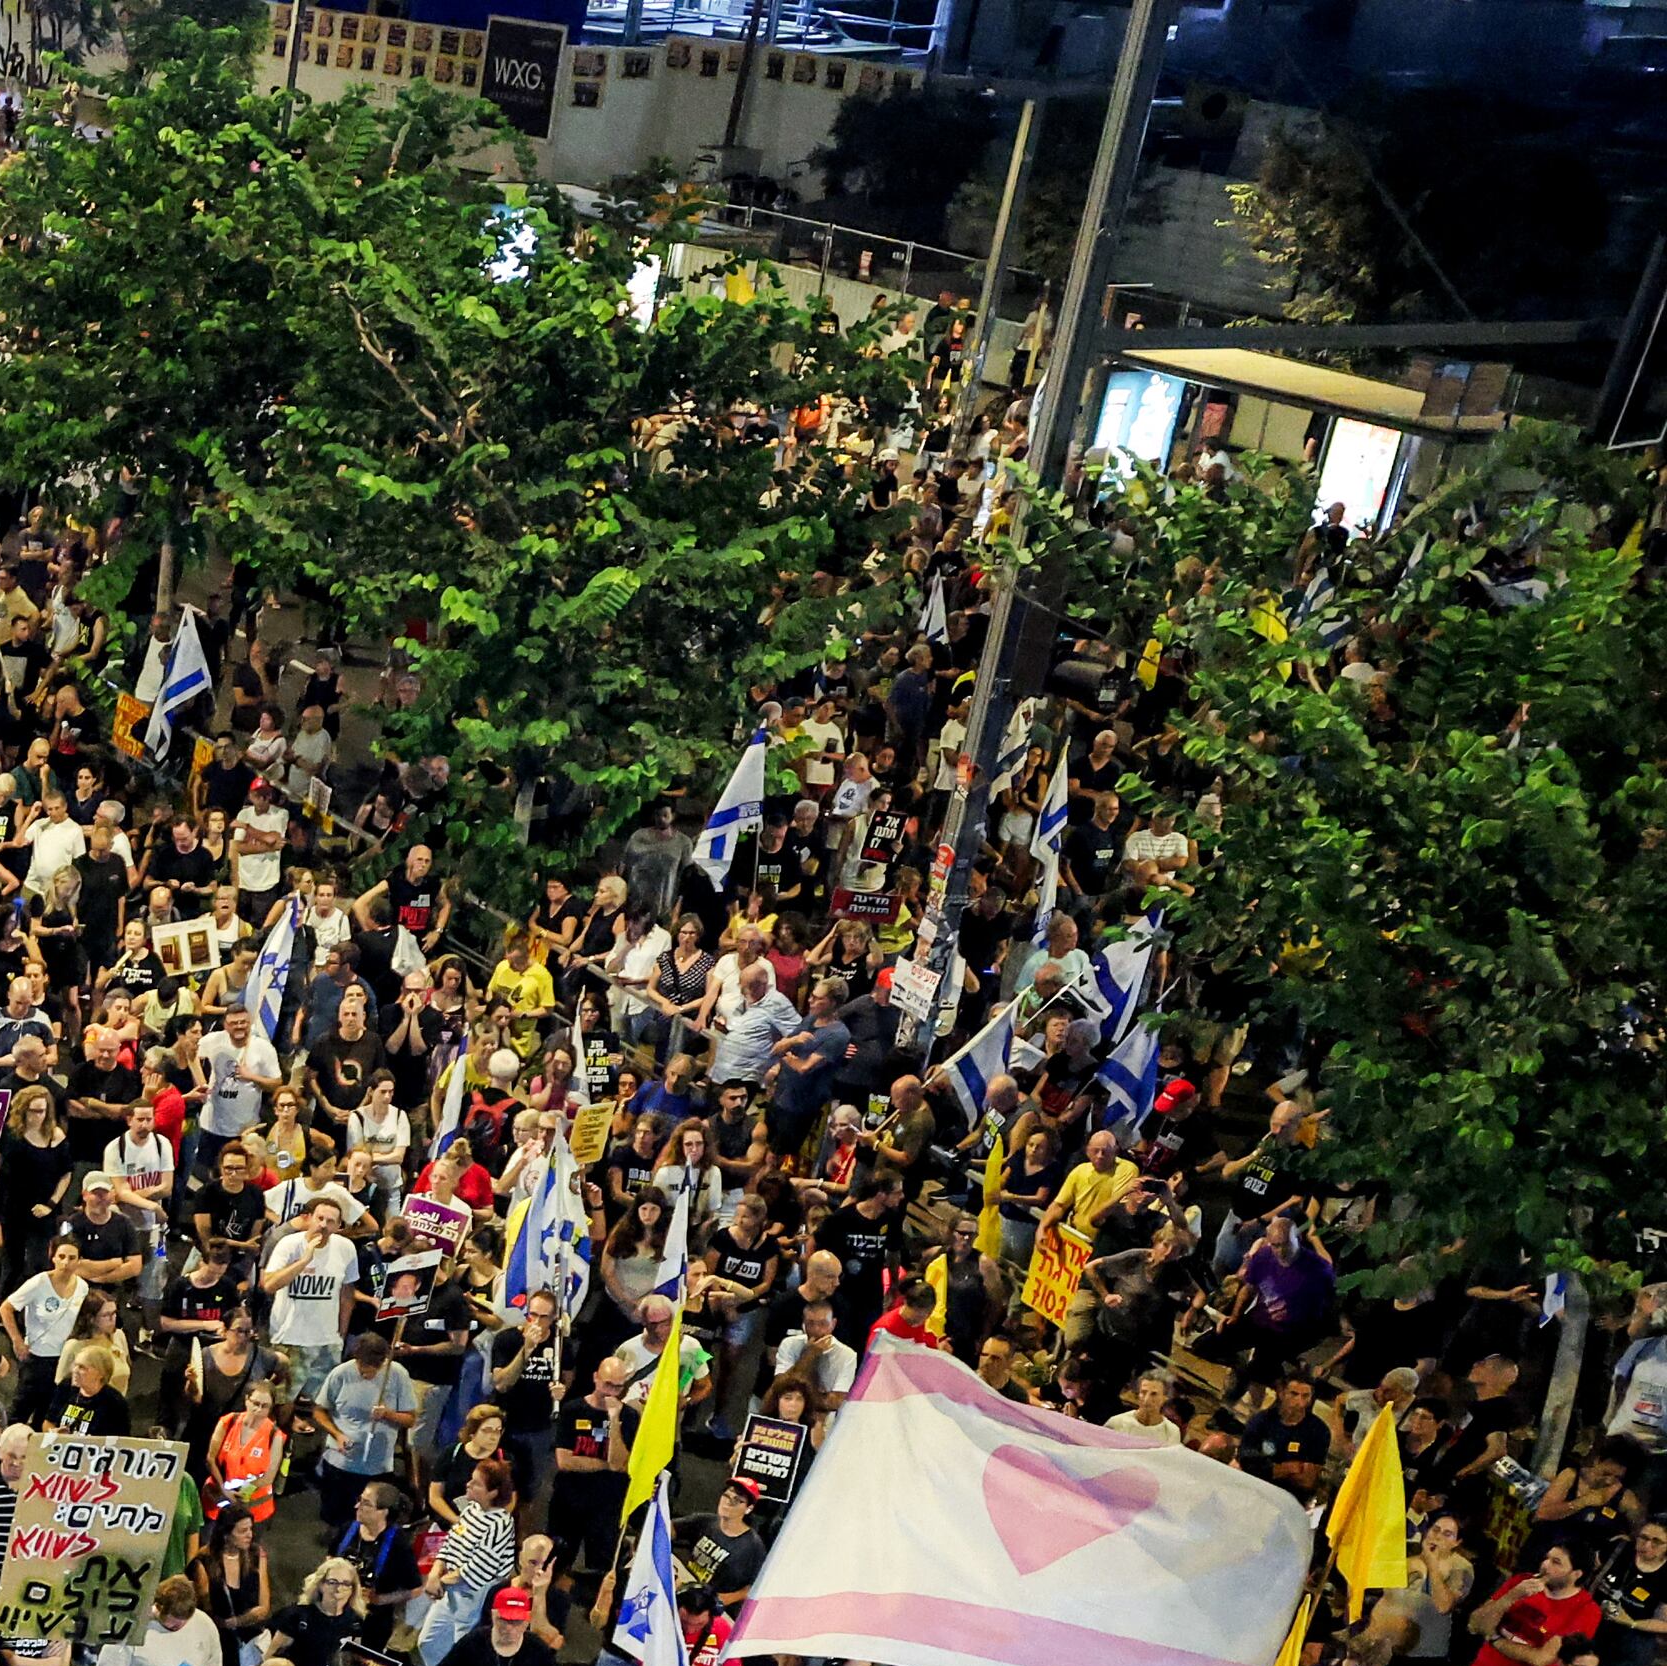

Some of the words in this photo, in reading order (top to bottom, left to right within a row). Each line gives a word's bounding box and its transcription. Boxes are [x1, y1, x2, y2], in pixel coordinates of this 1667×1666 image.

[46, 1445, 179, 1479] הורגים:
[23, 1472, 121, 1504] לשווא
[56, 1504, 163, 1532] מתים:
[9, 1524, 102, 1560] לשווא
